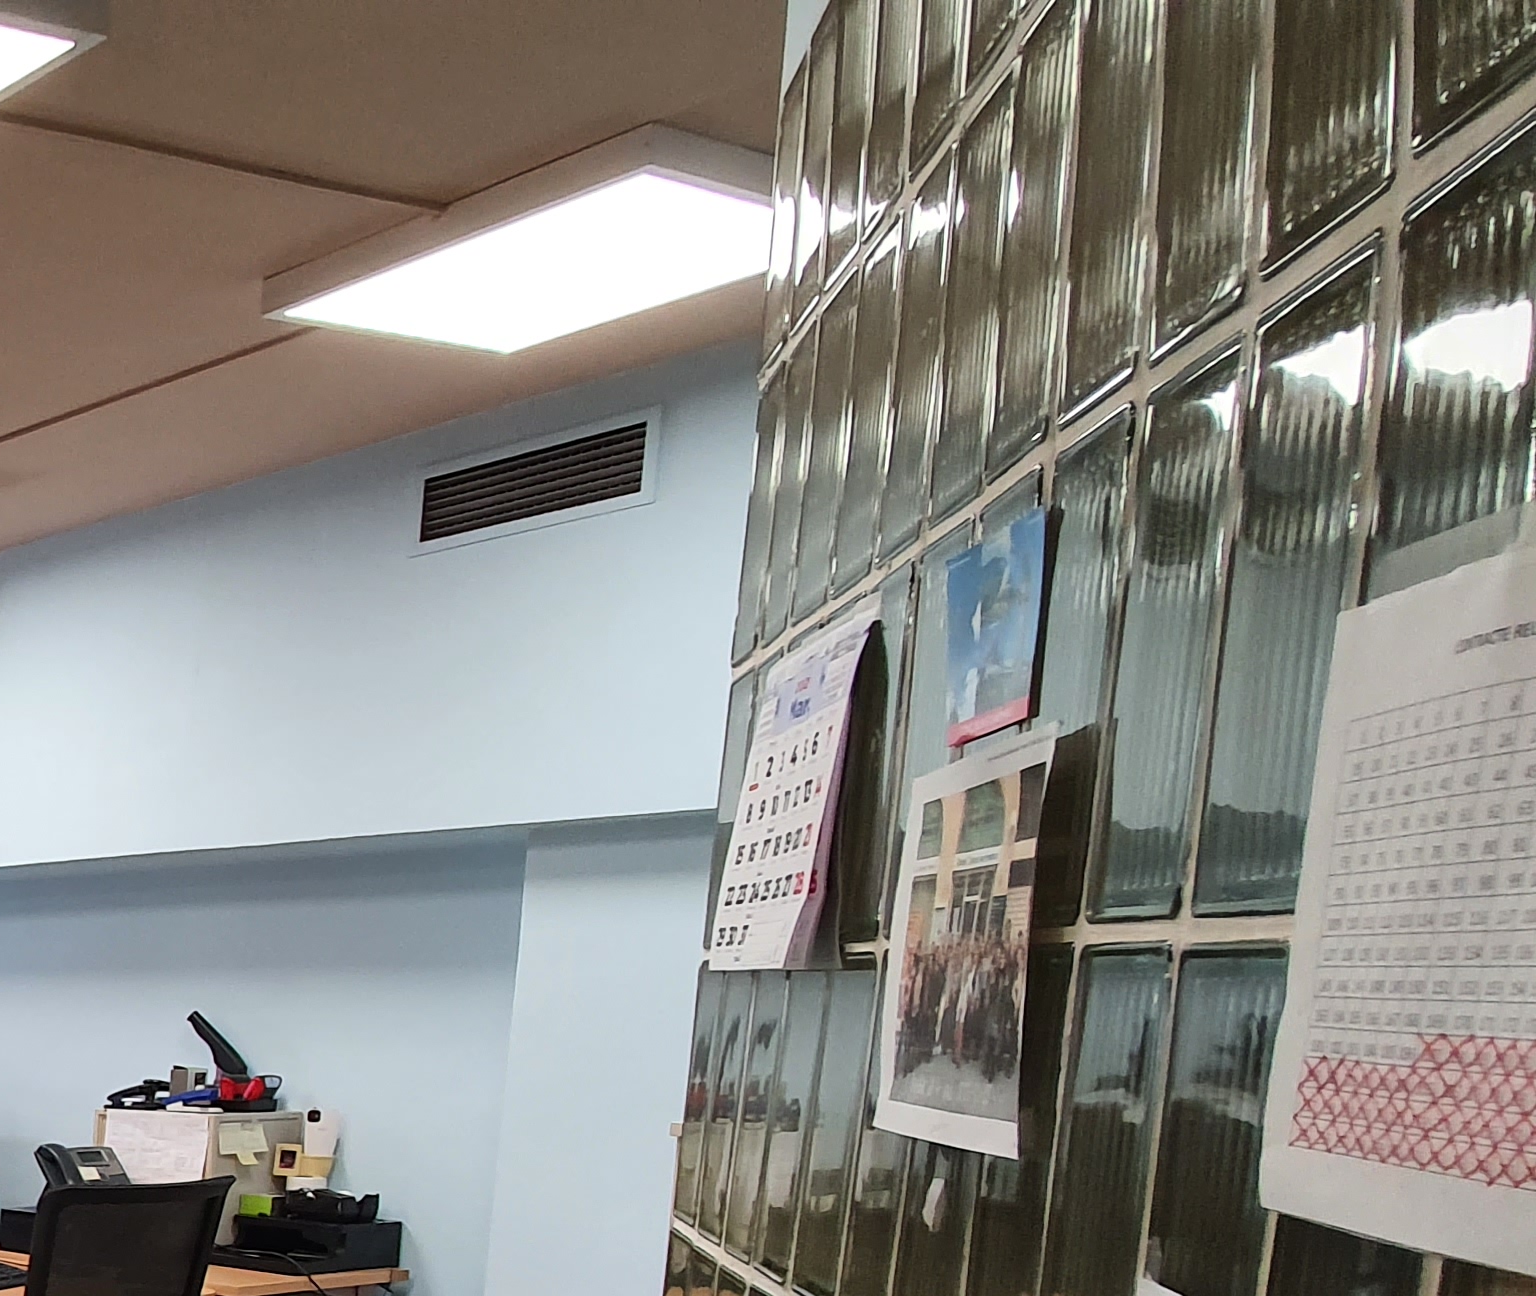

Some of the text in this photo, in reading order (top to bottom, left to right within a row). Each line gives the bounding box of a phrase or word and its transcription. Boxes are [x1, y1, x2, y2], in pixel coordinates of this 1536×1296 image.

[765, 756, 774, 777] 2
[790, 744, 798, 766] 4
[811, 731, 820, 755] 6
[758, 799, 766, 820] 9
